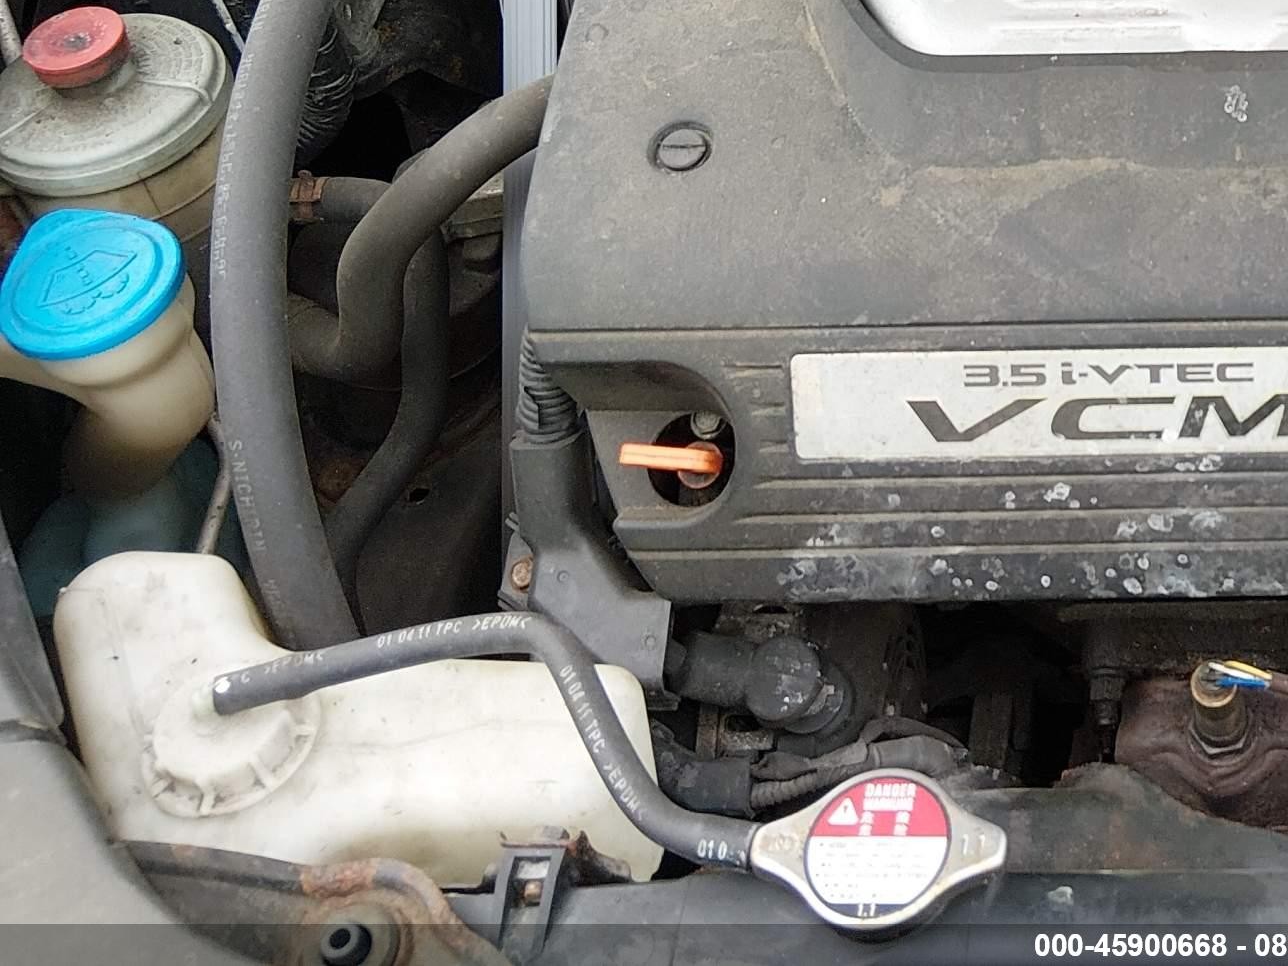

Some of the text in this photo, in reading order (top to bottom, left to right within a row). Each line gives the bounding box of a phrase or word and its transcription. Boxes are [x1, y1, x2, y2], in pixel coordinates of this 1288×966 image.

[964, 362, 1255, 387] 3.5 i-VTEC
[864, 782, 917, 797] DANGER
